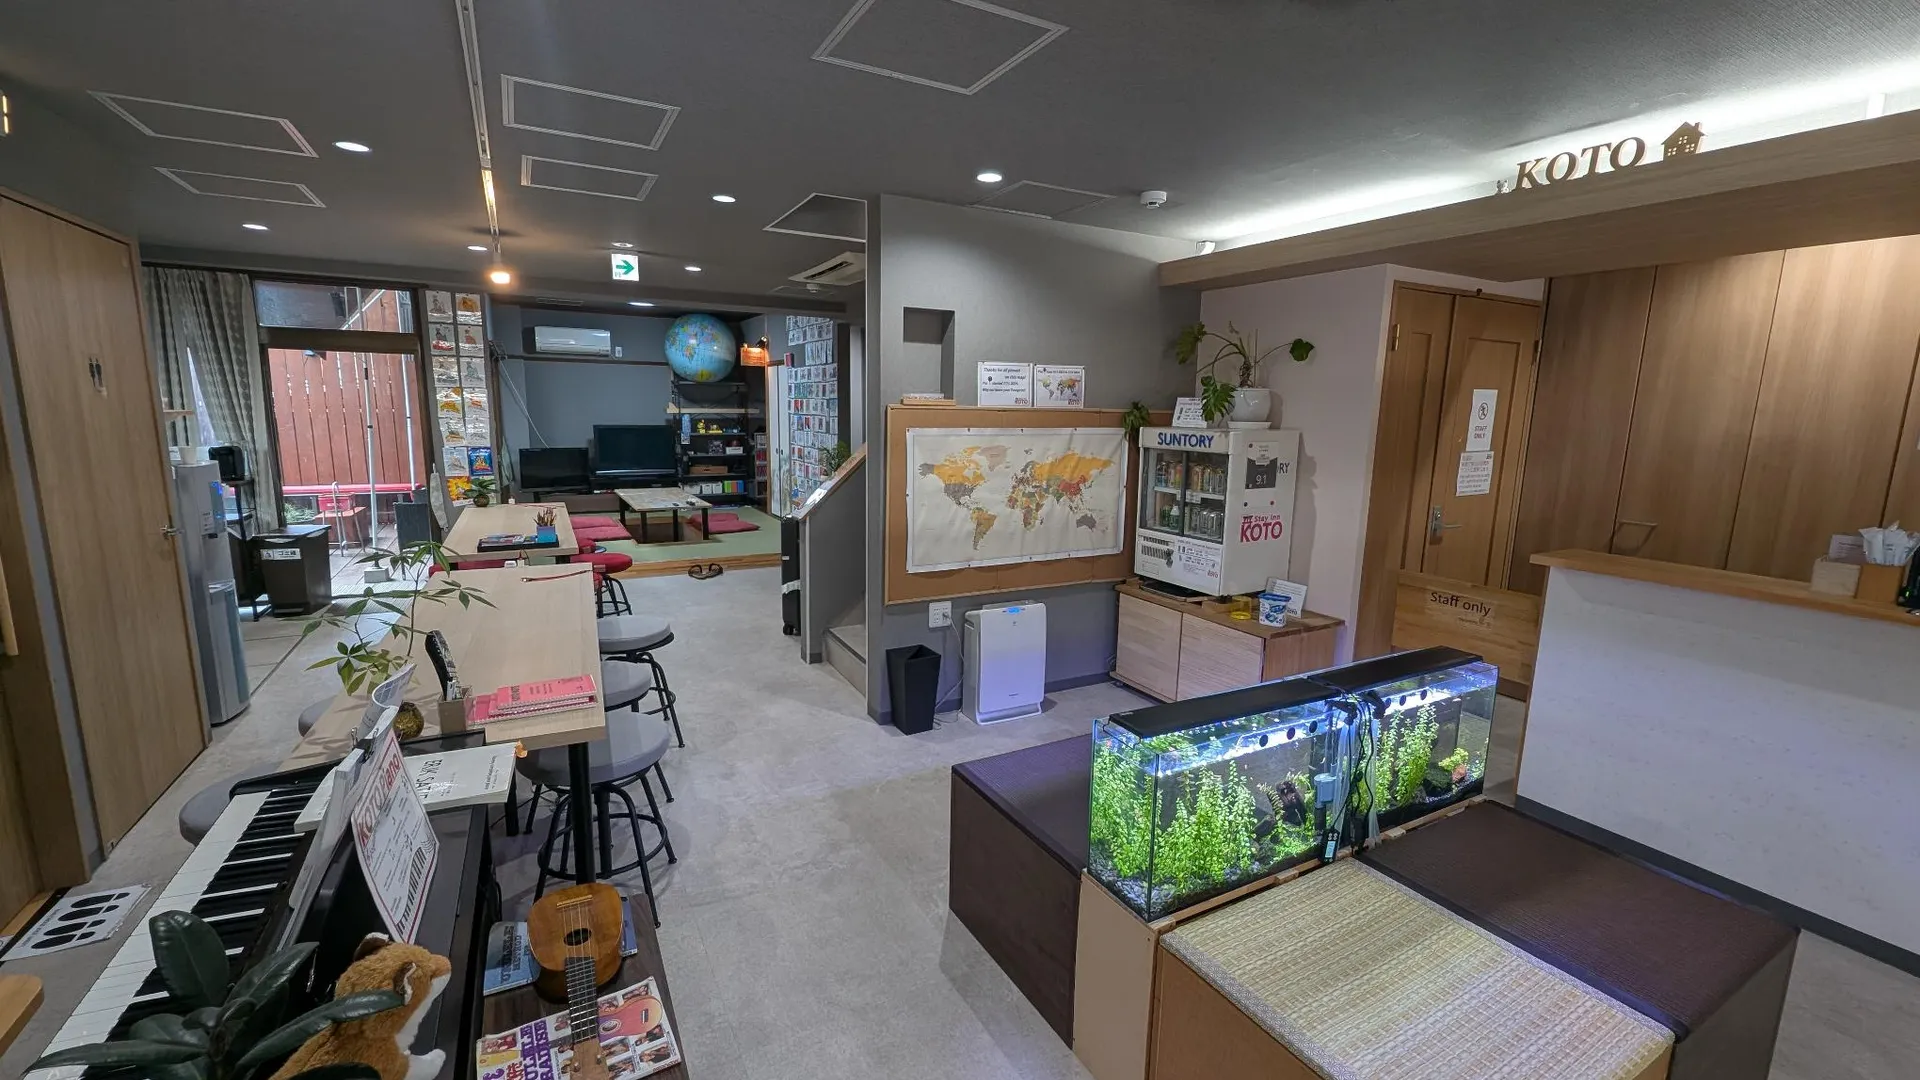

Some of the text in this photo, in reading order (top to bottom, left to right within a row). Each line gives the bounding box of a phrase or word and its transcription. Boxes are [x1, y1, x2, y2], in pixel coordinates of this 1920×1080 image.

[1514, 137, 1646, 190] KOTO
[1157, 432, 1214, 448] SUNTORY
[1254, 515, 1269, 523] Stay
[1240, 521, 1283, 543] KOTO
[1430, 591, 1491, 617] Staff only
[419, 759, 443, 777] ERIK
[357, 753, 400, 849] KOTO Piano
